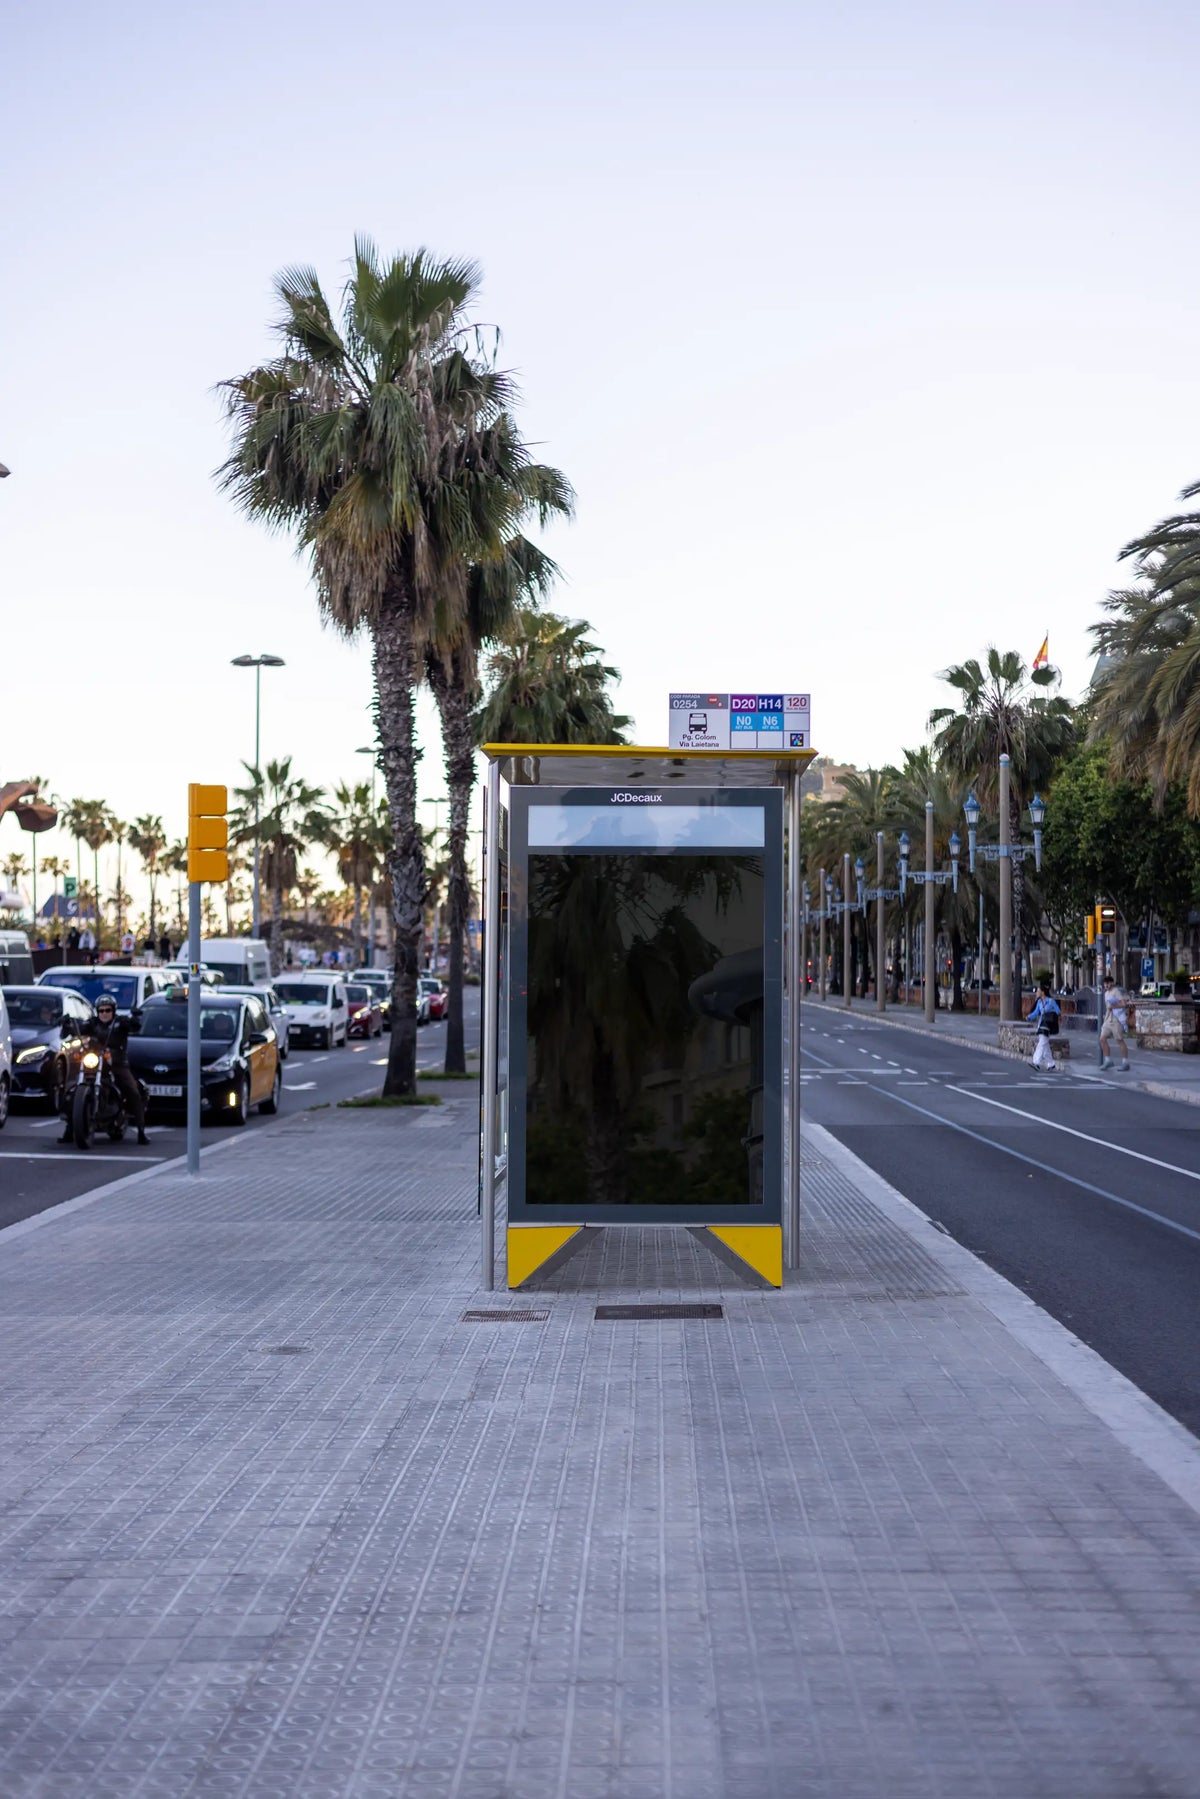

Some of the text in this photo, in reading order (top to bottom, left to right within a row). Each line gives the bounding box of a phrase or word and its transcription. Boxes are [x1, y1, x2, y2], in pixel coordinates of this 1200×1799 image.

[673, 699, 698, 709] 0254
[732, 699, 756, 709] D20
[758, 699, 782, 709] H14
[787, 697, 807, 707] 120
[736, 715, 752, 726] N0
[763, 715, 778, 726] N6
[682, 734, 693, 742] Pg.
[611, 793, 662, 802] JCDecaux
[66, 883, 75, 896] P
[1144, 959, 1152, 970] P
